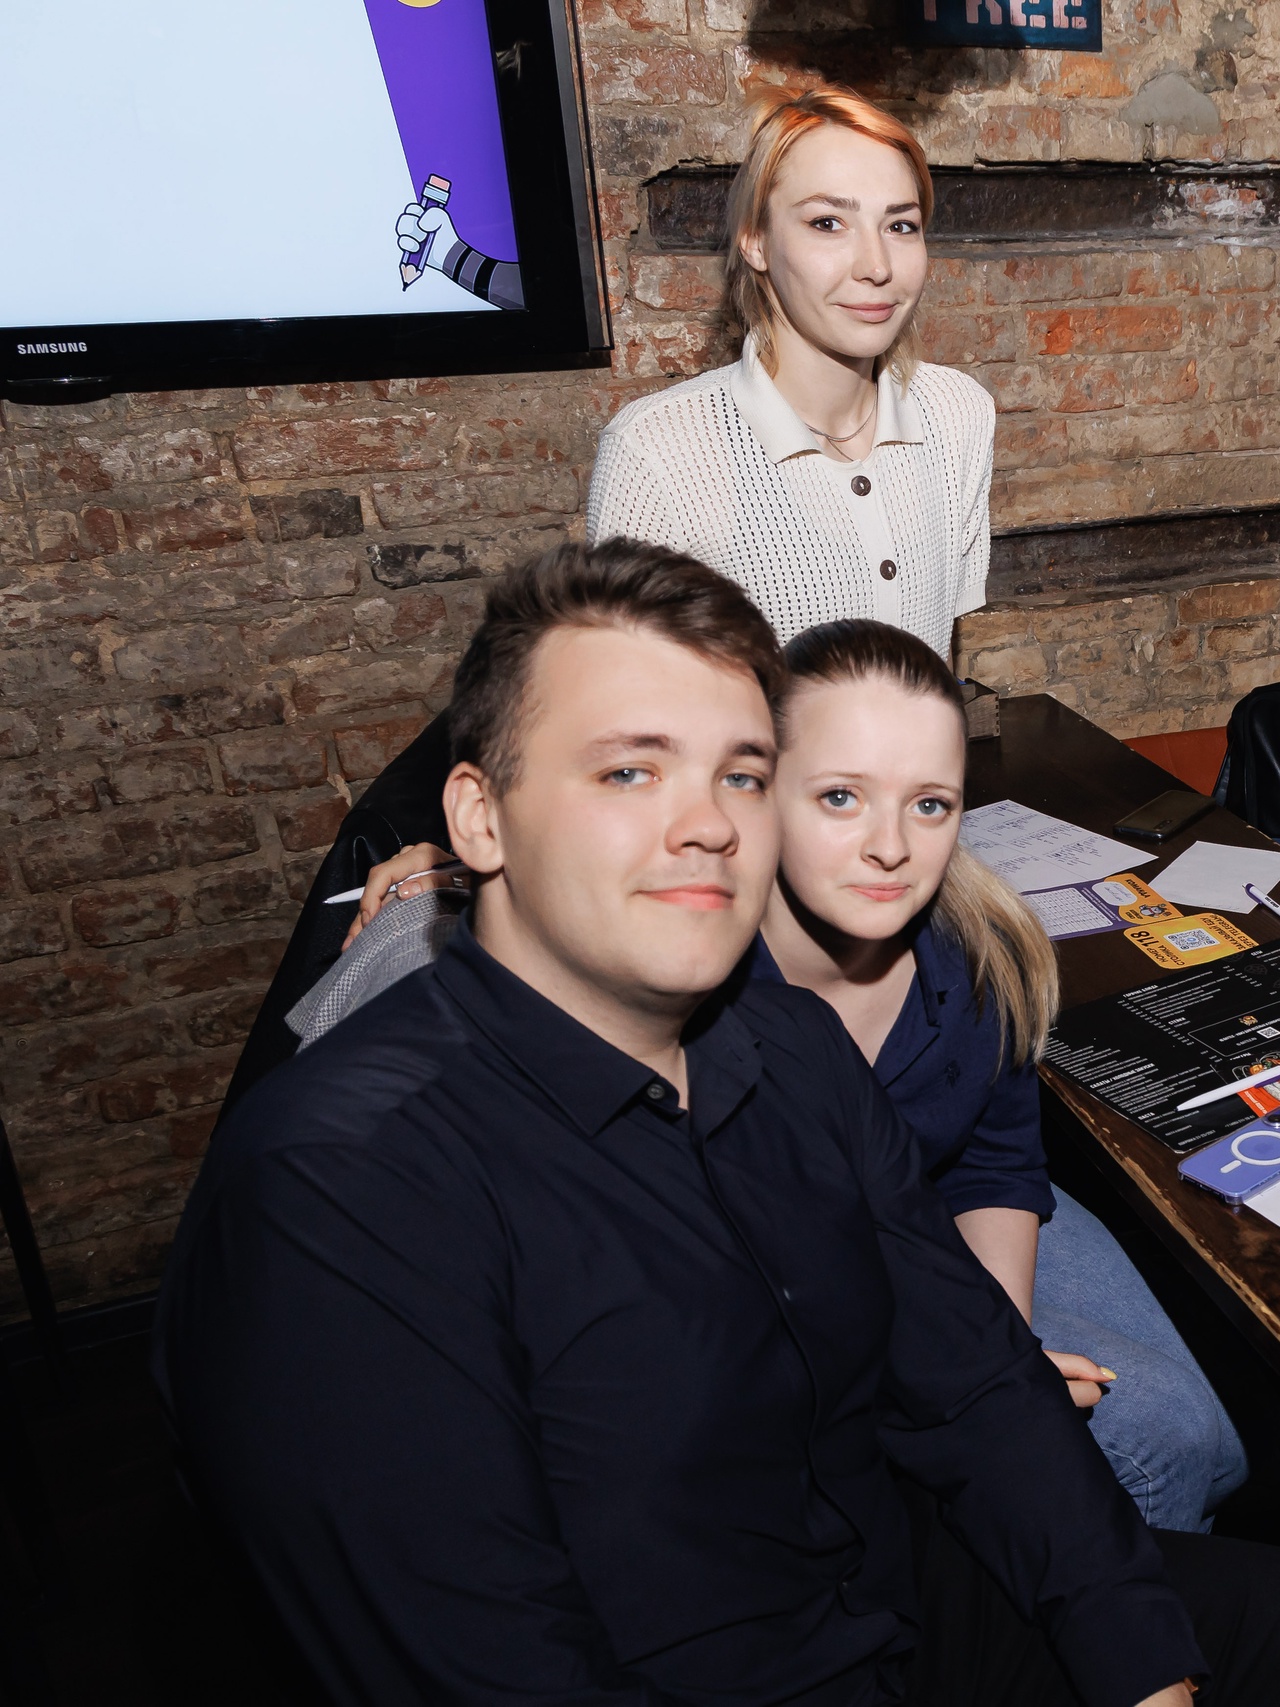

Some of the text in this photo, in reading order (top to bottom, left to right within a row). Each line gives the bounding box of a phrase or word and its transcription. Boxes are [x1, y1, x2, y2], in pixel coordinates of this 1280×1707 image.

[17, 342, 88, 354] SAMSUNG
[1130, 930, 1160, 947] 118
[1210, 924, 1246, 951] ЗАКАЗЫВАЙ
[1147, 947, 1169, 963] НОМЕР
[1159, 945, 1185, 966] СТОЛИКА
[1089, 1079, 1112, 1088] САЛАТЫ
